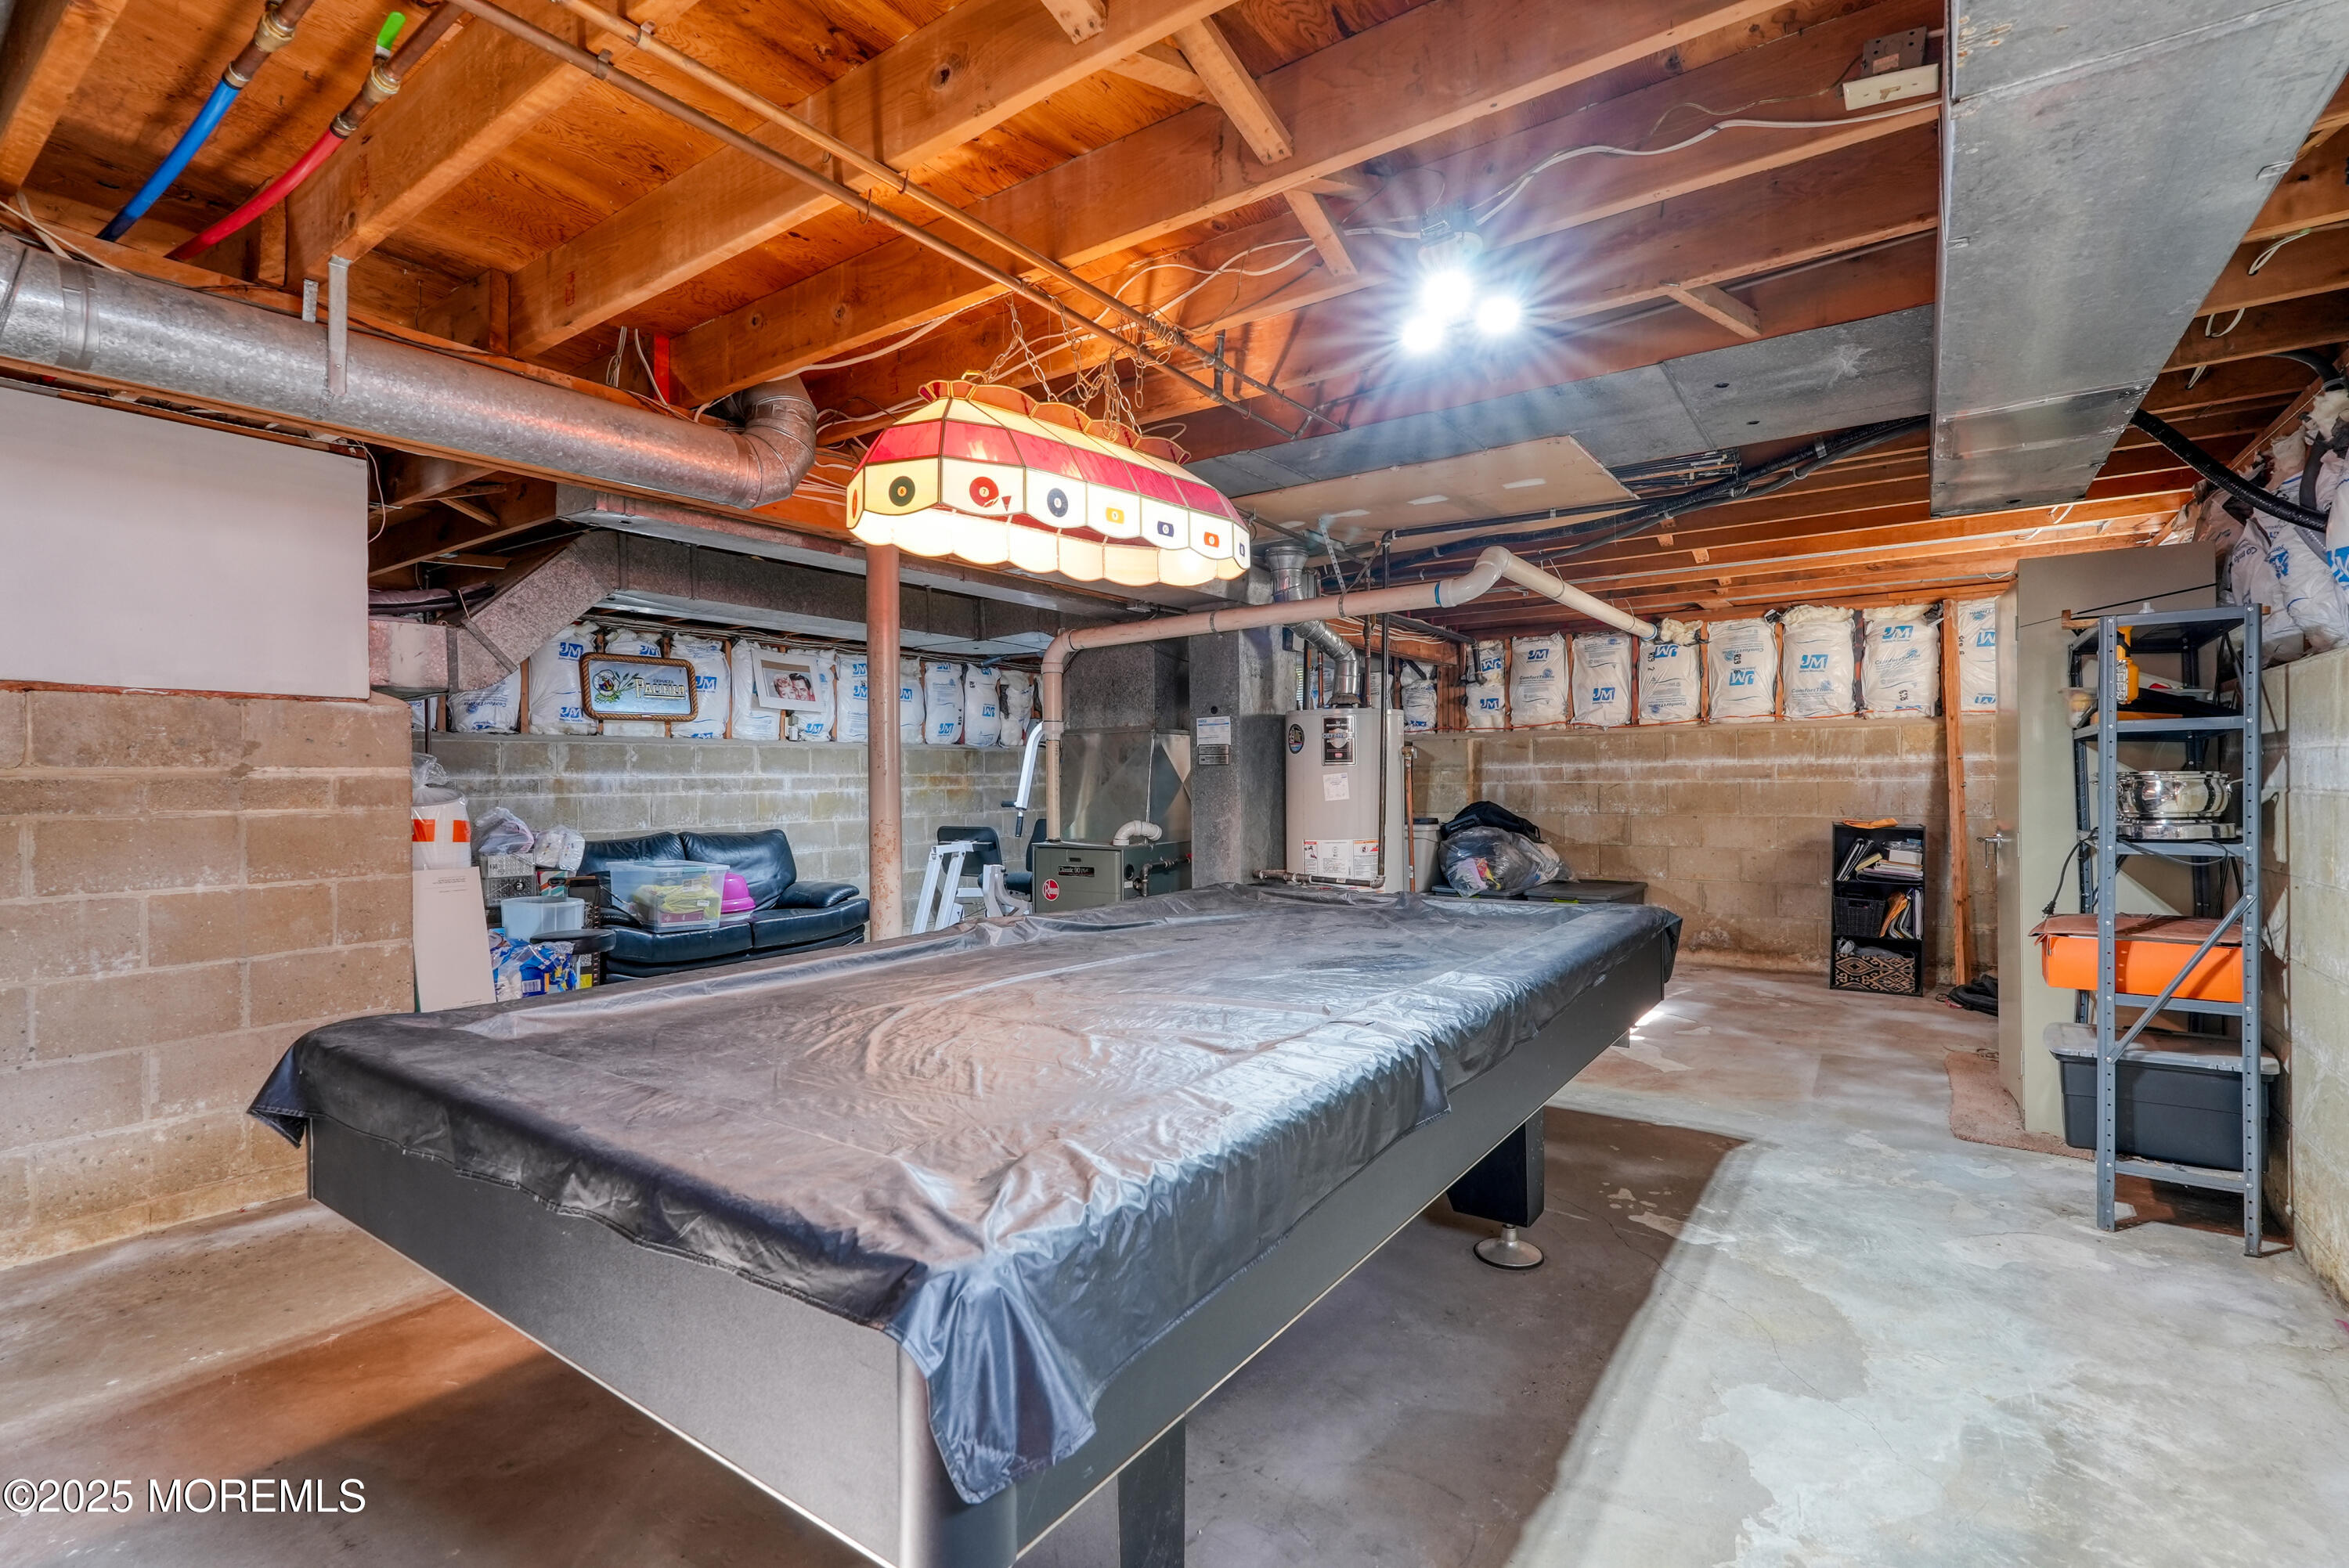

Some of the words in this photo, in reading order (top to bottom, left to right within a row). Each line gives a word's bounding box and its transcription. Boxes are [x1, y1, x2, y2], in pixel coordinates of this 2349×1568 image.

[1881, 625, 1914, 640] JM
[1528, 648, 1550, 660] JM
[1655, 644, 1679, 658] JM
[1799, 654, 1828, 669] JM
[1729, 670, 1755, 686] JM
[1592, 687, 1615, 701] JM
[1480, 698, 1499, 709] JM
[938, 723, 954, 734] JM
